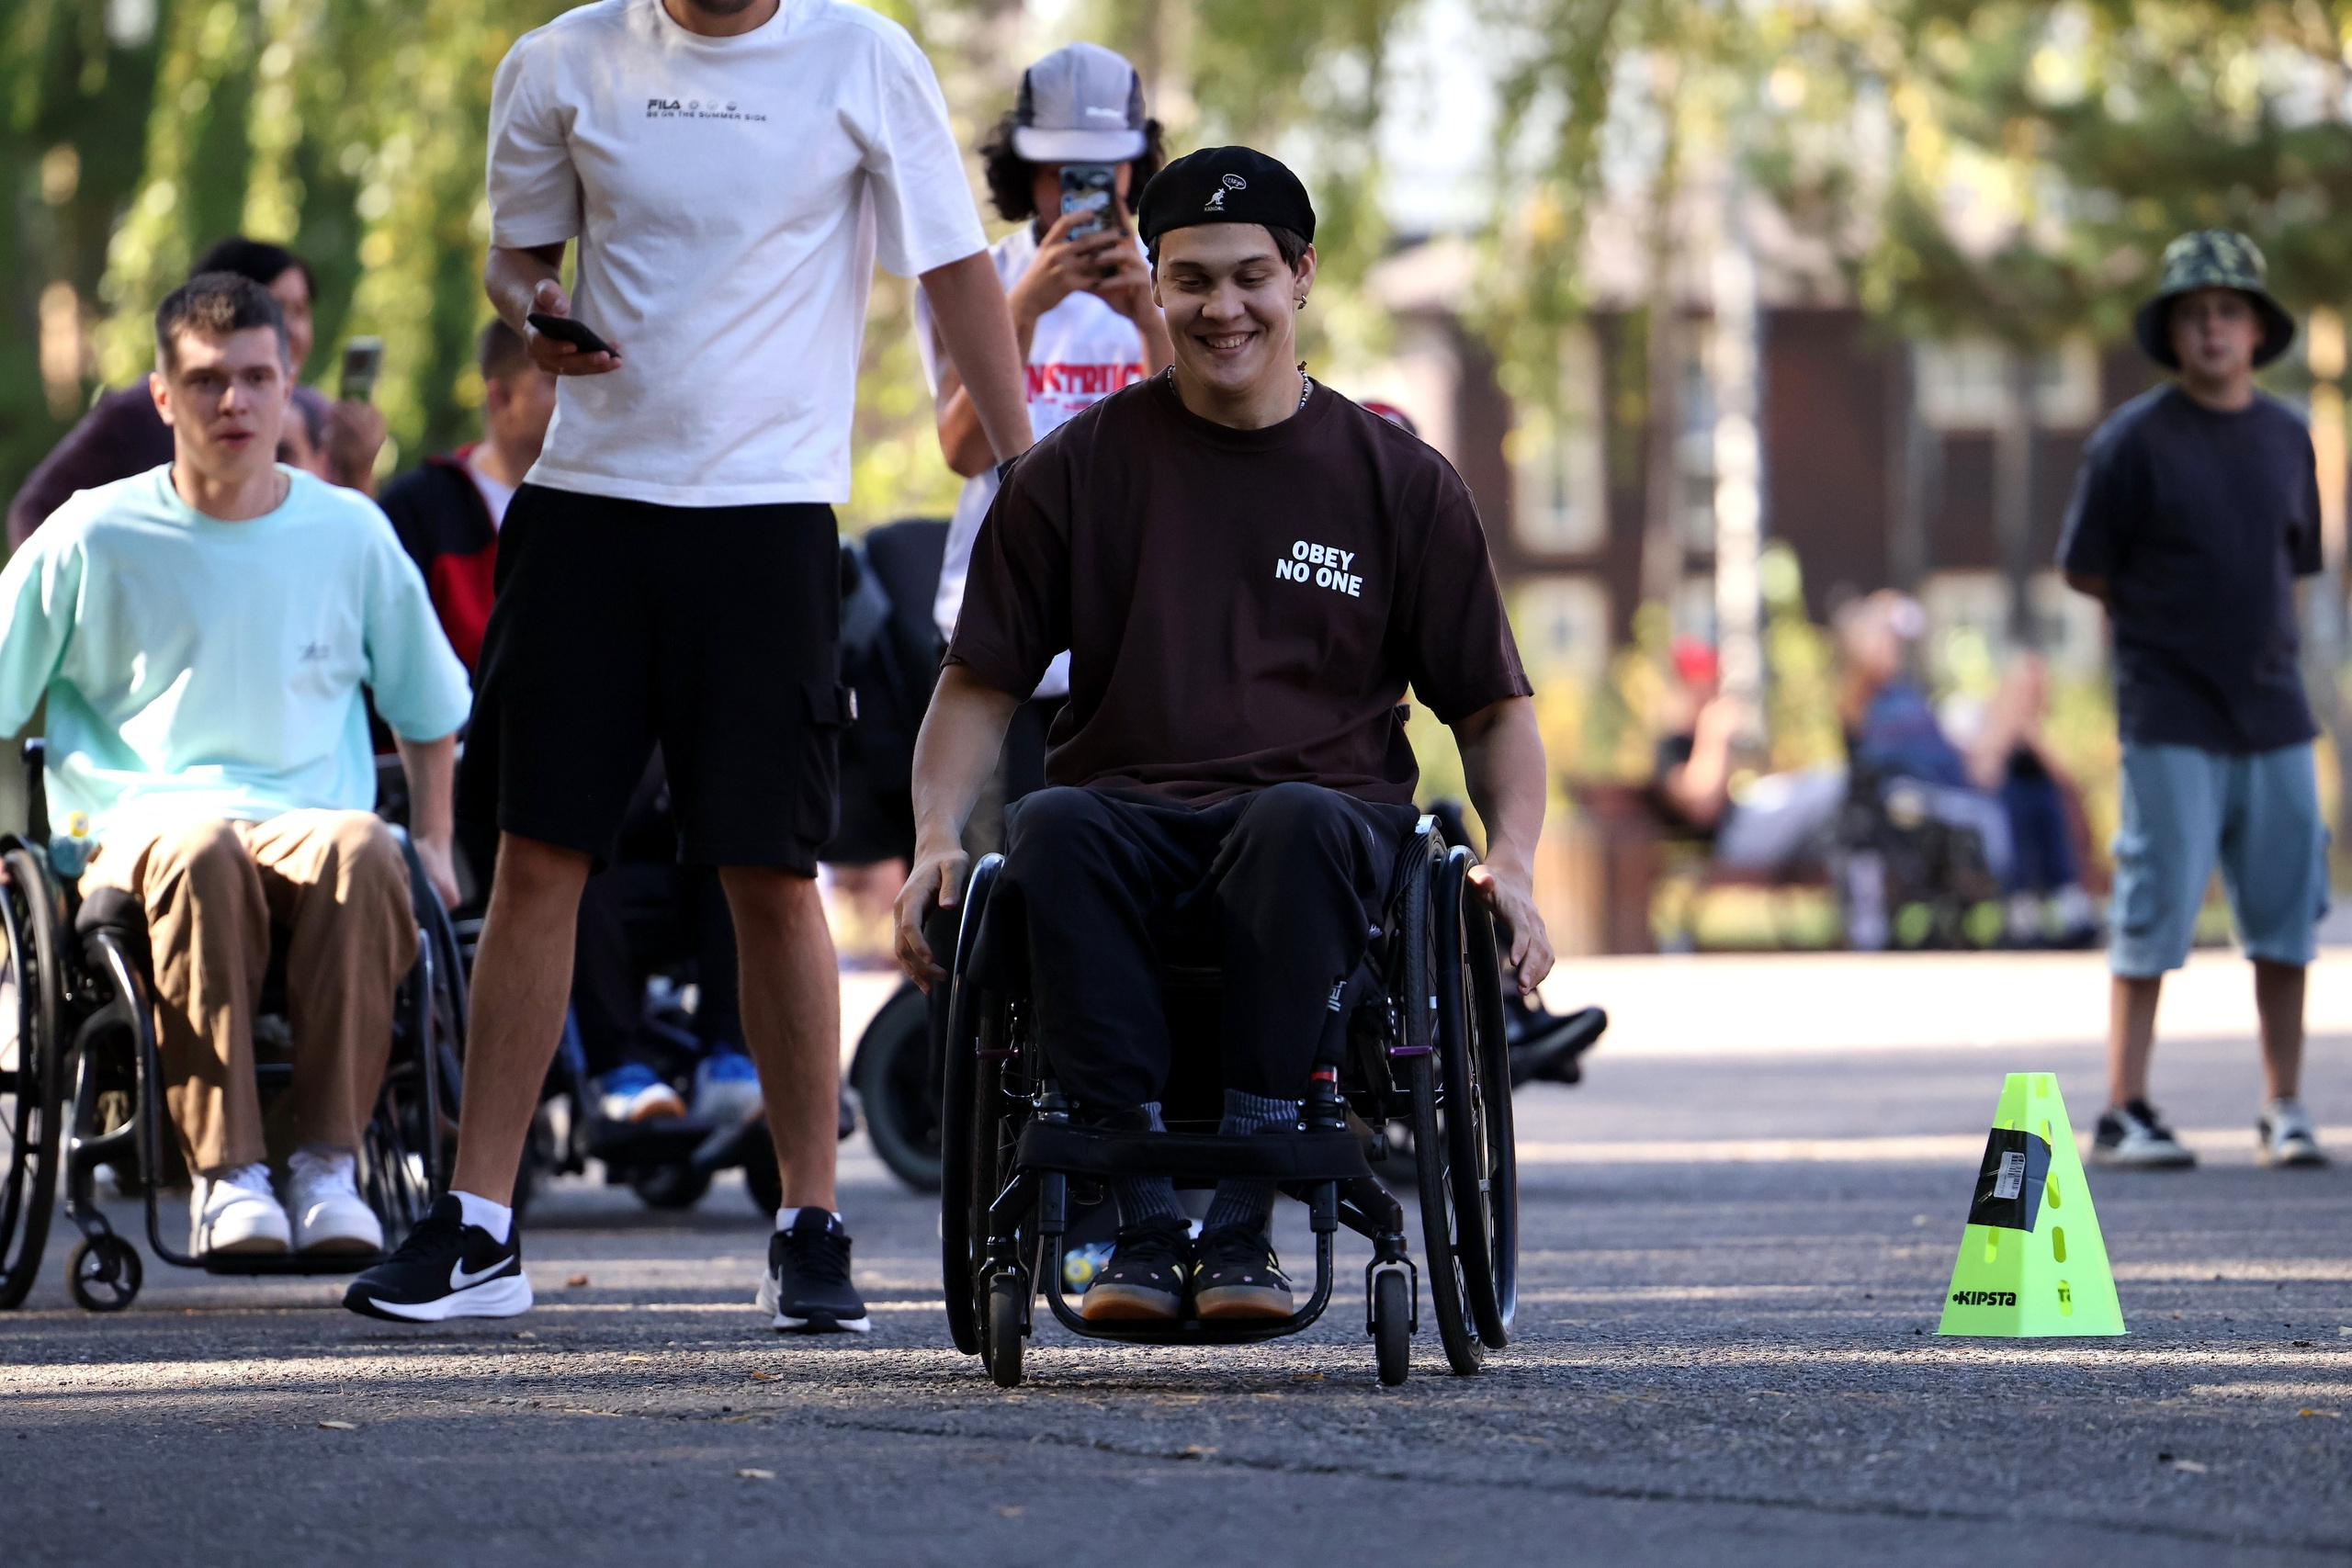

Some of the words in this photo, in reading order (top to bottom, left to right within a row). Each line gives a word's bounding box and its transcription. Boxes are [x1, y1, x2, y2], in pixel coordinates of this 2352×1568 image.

[648, 99, 681, 109] FILA
[699, 111, 741, 119] SUMMER
[1292, 540, 1355, 570] OBEY
[1275, 558, 1310, 583] NO
[1316, 567, 1363, 598] ONE
